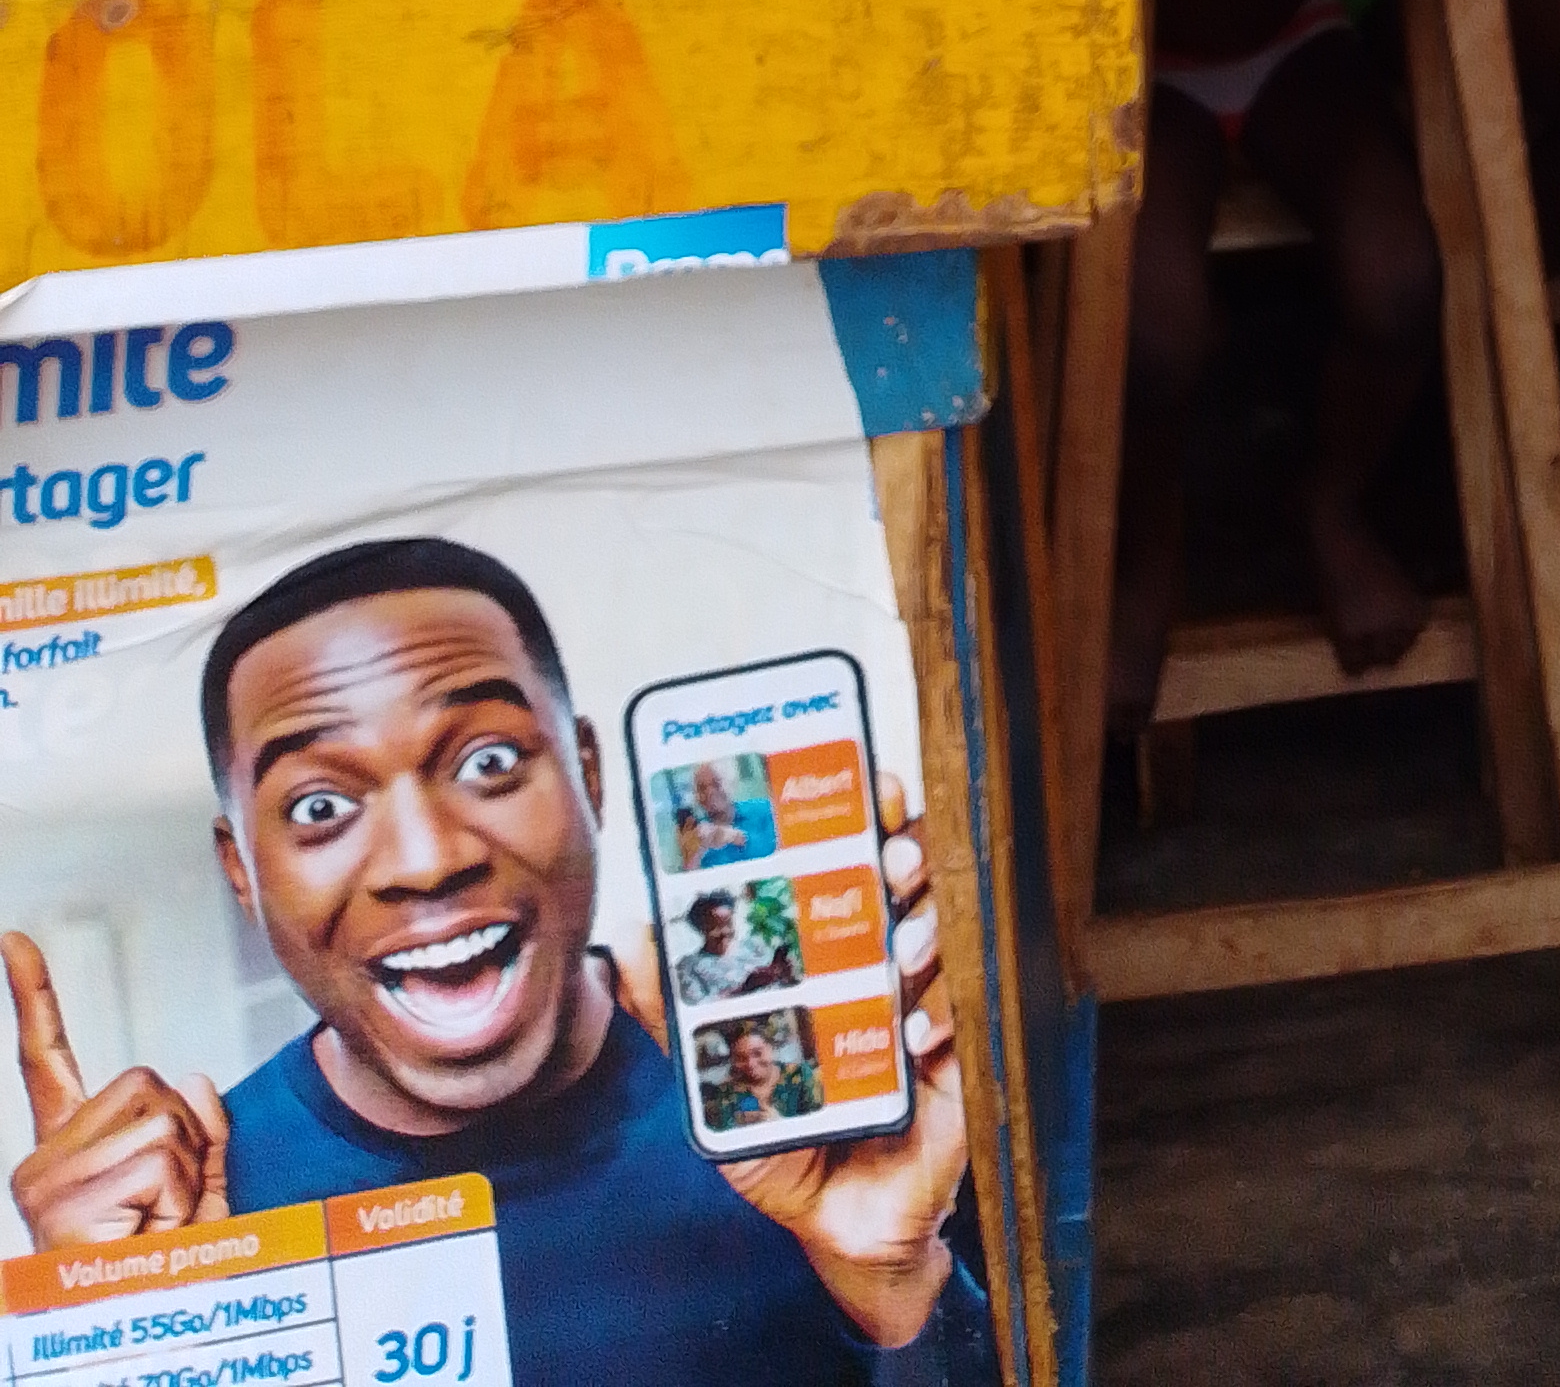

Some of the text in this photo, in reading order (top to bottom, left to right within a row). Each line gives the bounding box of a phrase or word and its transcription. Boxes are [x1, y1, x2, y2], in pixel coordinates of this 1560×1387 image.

[1, 630, 102, 675] forfait
[661, 689, 840, 745] Partagez avec
[57, 1187, 466, 1292] Volume promo Validité
[373, 1313, 478, 1385] 30 j
